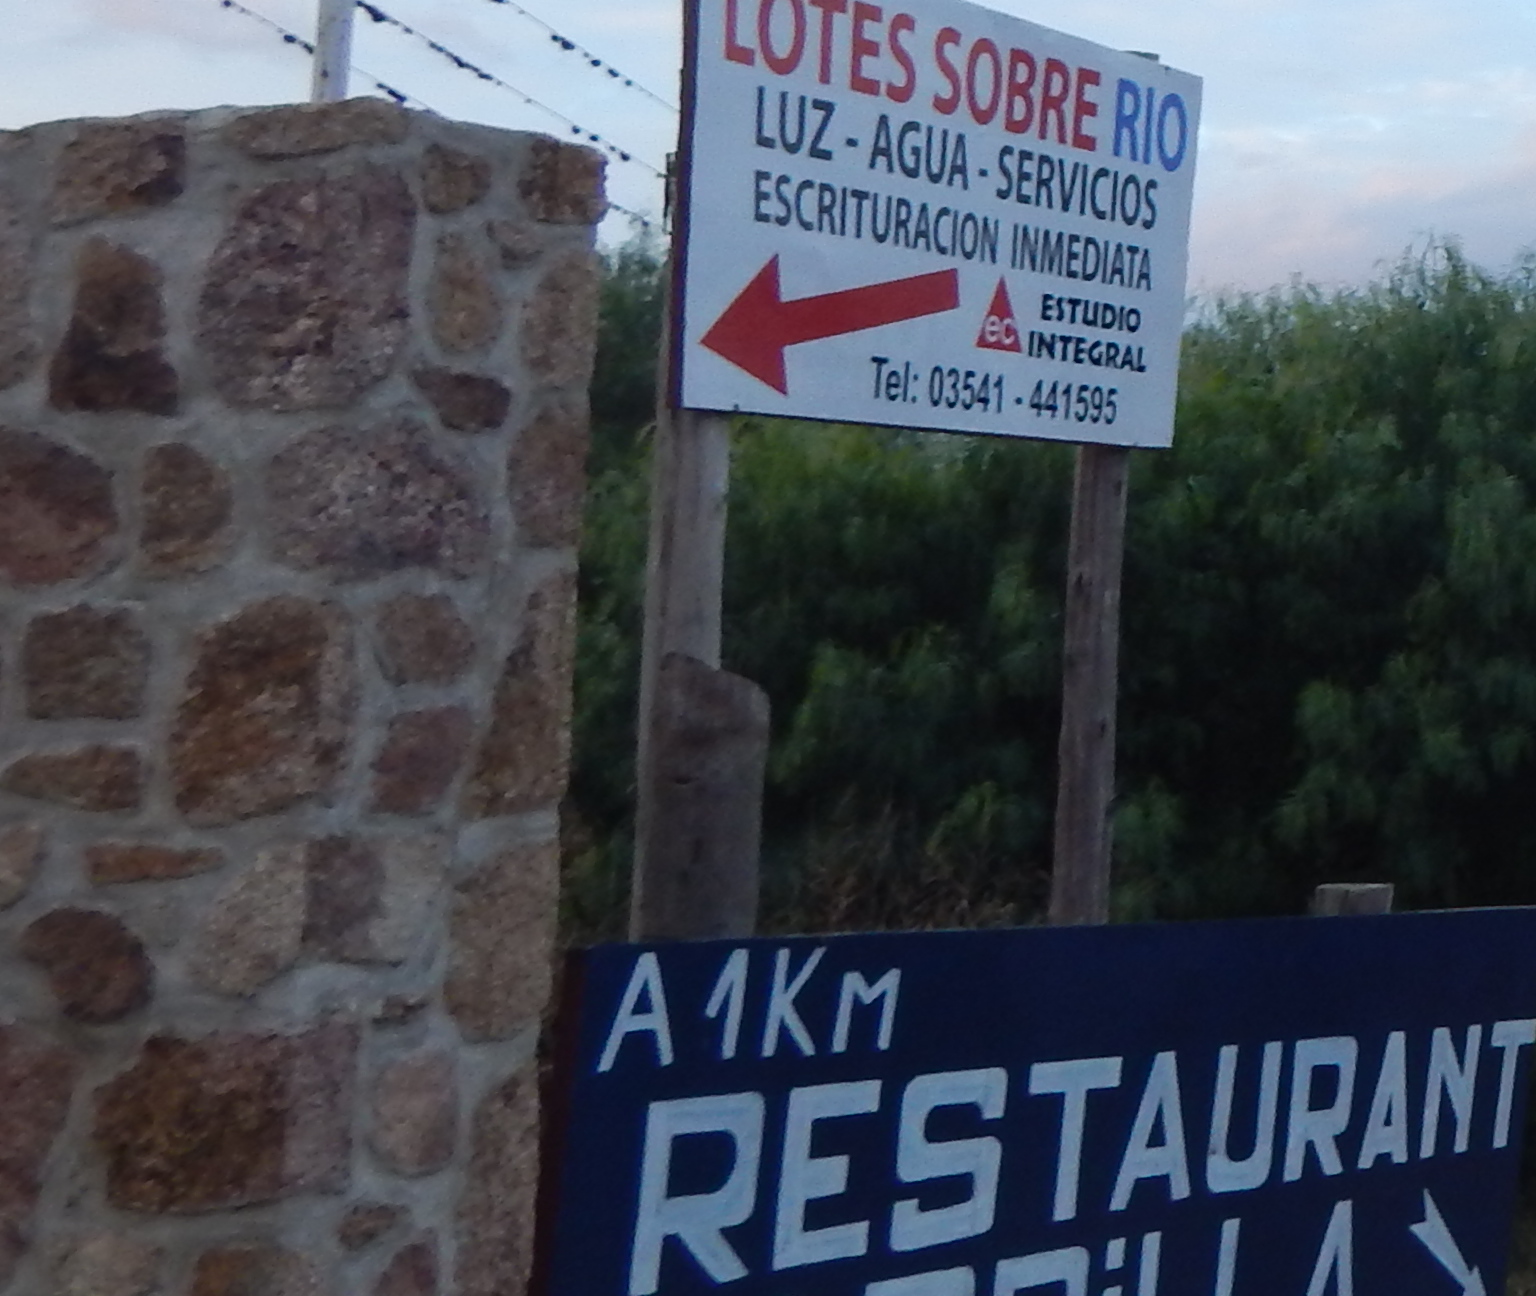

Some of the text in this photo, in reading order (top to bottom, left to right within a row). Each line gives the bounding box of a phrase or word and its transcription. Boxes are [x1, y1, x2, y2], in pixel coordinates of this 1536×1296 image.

[931, 26, 1101, 152] SOBRE
[1112, 77, 1189, 172] RIO
[754, 86, 837, 161] LUZ
[869, 113, 969, 191] AGUA
[995, 145, 1158, 230] SERVICIOS
[753, 169, 1152, 291] ESCRITURACION INMEDIATA
[984, 315, 1016, 345] ec
[1028, 330, 1148, 373] INTEGRAL
[1040, 293, 1142, 333] ESTUDIO
[870, 356, 920, 405] Tel:
[928, 366, 1005, 414] 03541
[1028, 378, 1119, 425] 441595
[597, 950, 676, 1073] A
